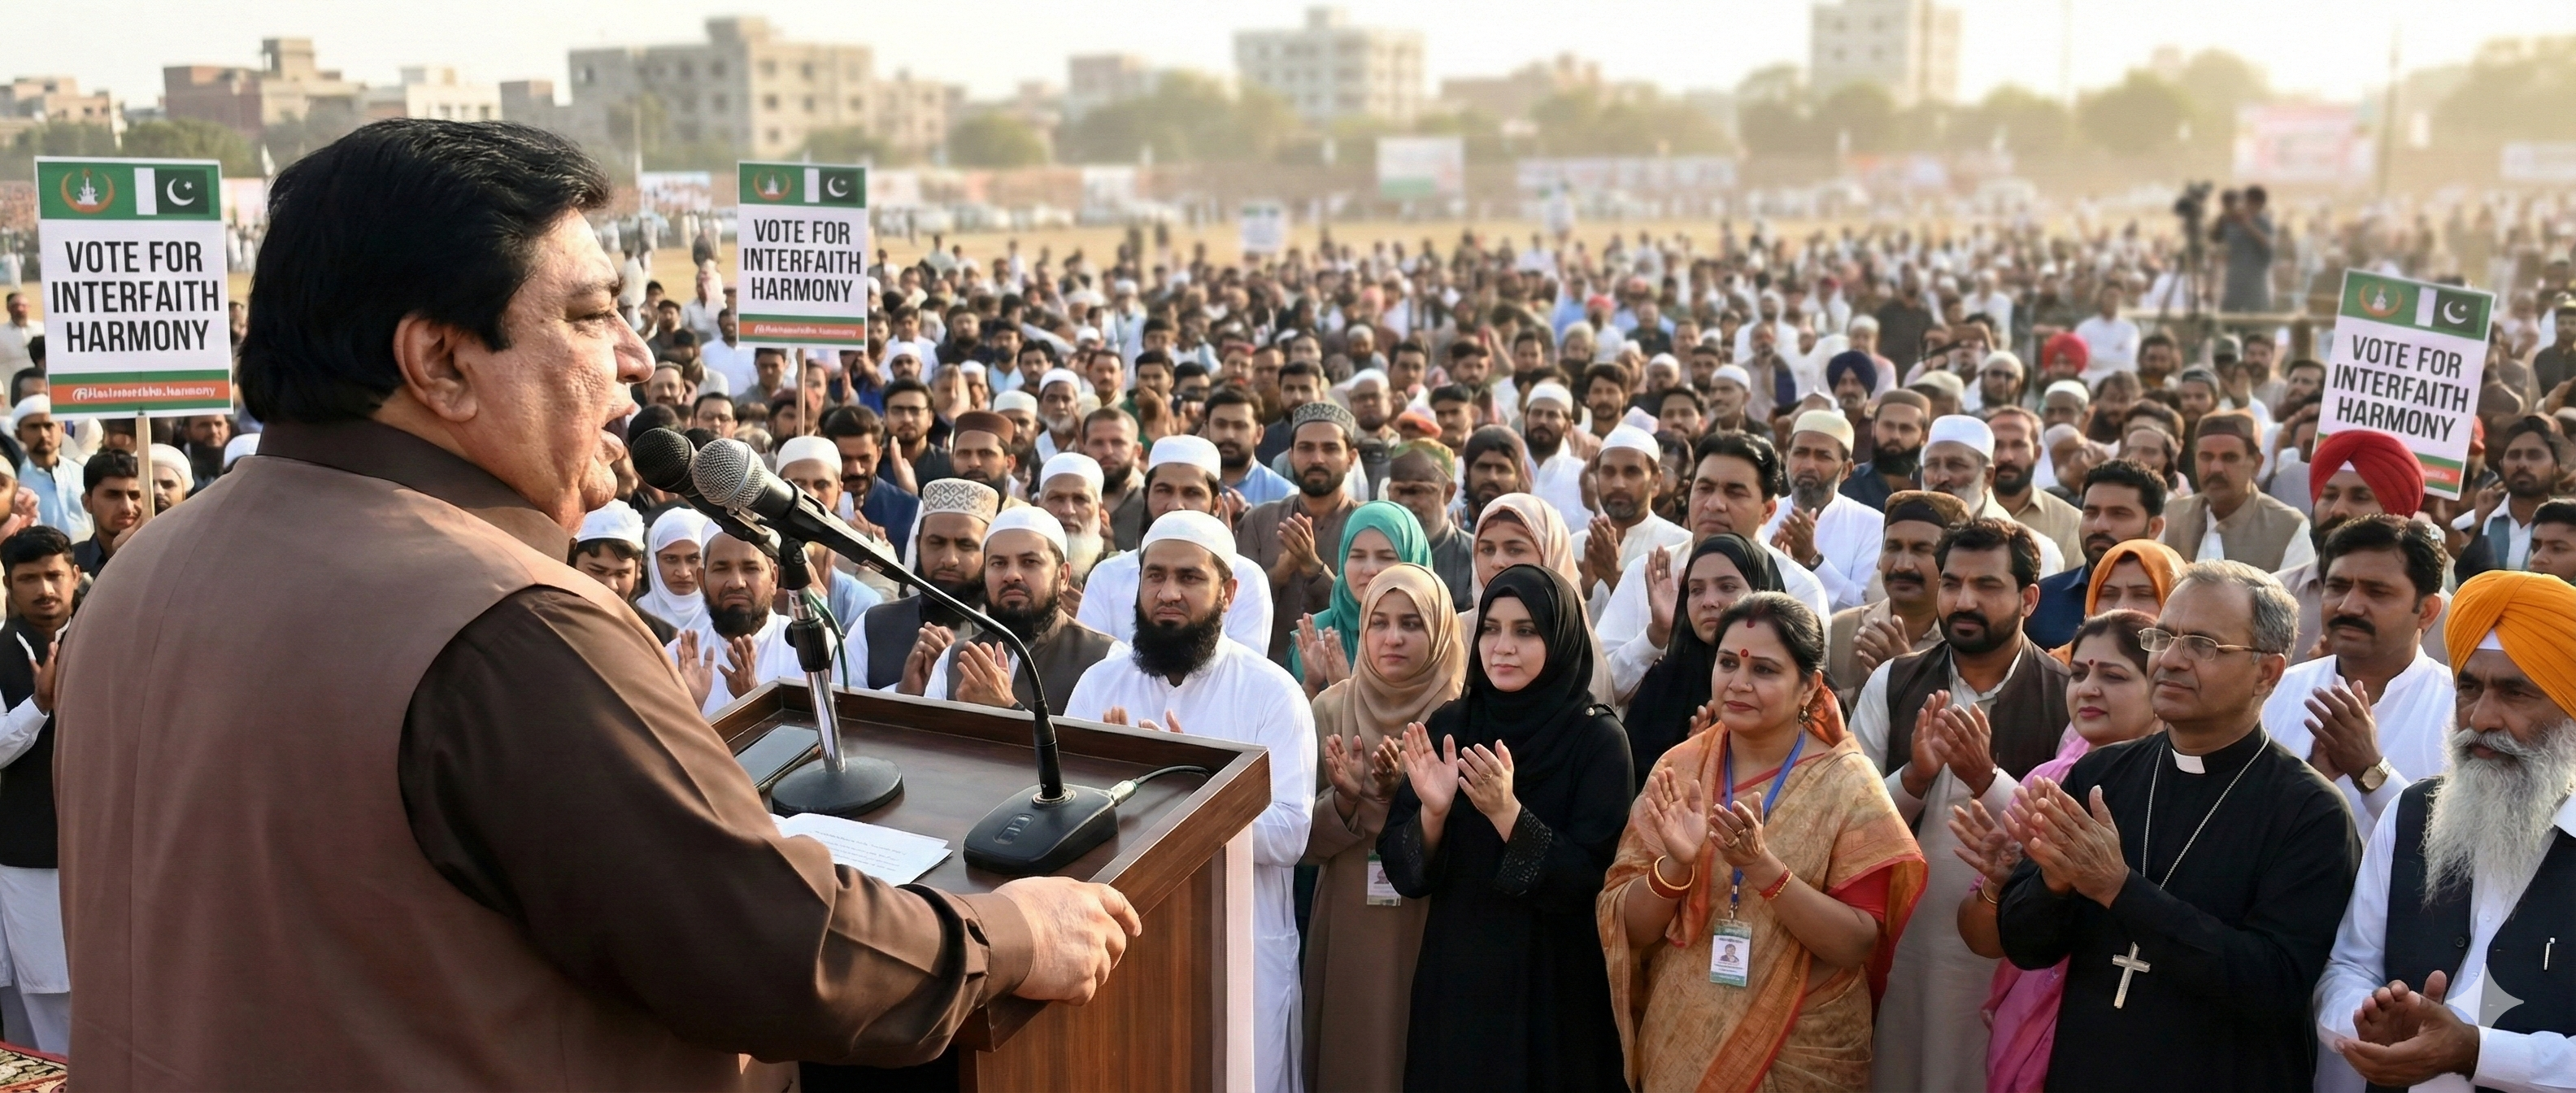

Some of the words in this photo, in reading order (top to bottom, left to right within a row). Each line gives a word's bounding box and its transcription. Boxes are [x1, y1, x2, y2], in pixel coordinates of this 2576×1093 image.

[754, 219, 805, 243] VOTE
[812, 220, 851, 245] FOR
[65, 241, 140, 272] VOTE
[149, 241, 202, 272] FOR
[743, 248, 861, 274] INTERFAITH
[51, 280, 220, 313] INTERFAITH
[751, 277, 853, 303] HARMONY
[66, 320, 209, 352] HARMONY
[2352, 334, 2411, 369] VOTE
[2417, 346, 2462, 379] FOR
[2333, 364, 2469, 413] INTERFAITH
[2336, 396, 2456, 442] HARMONY
